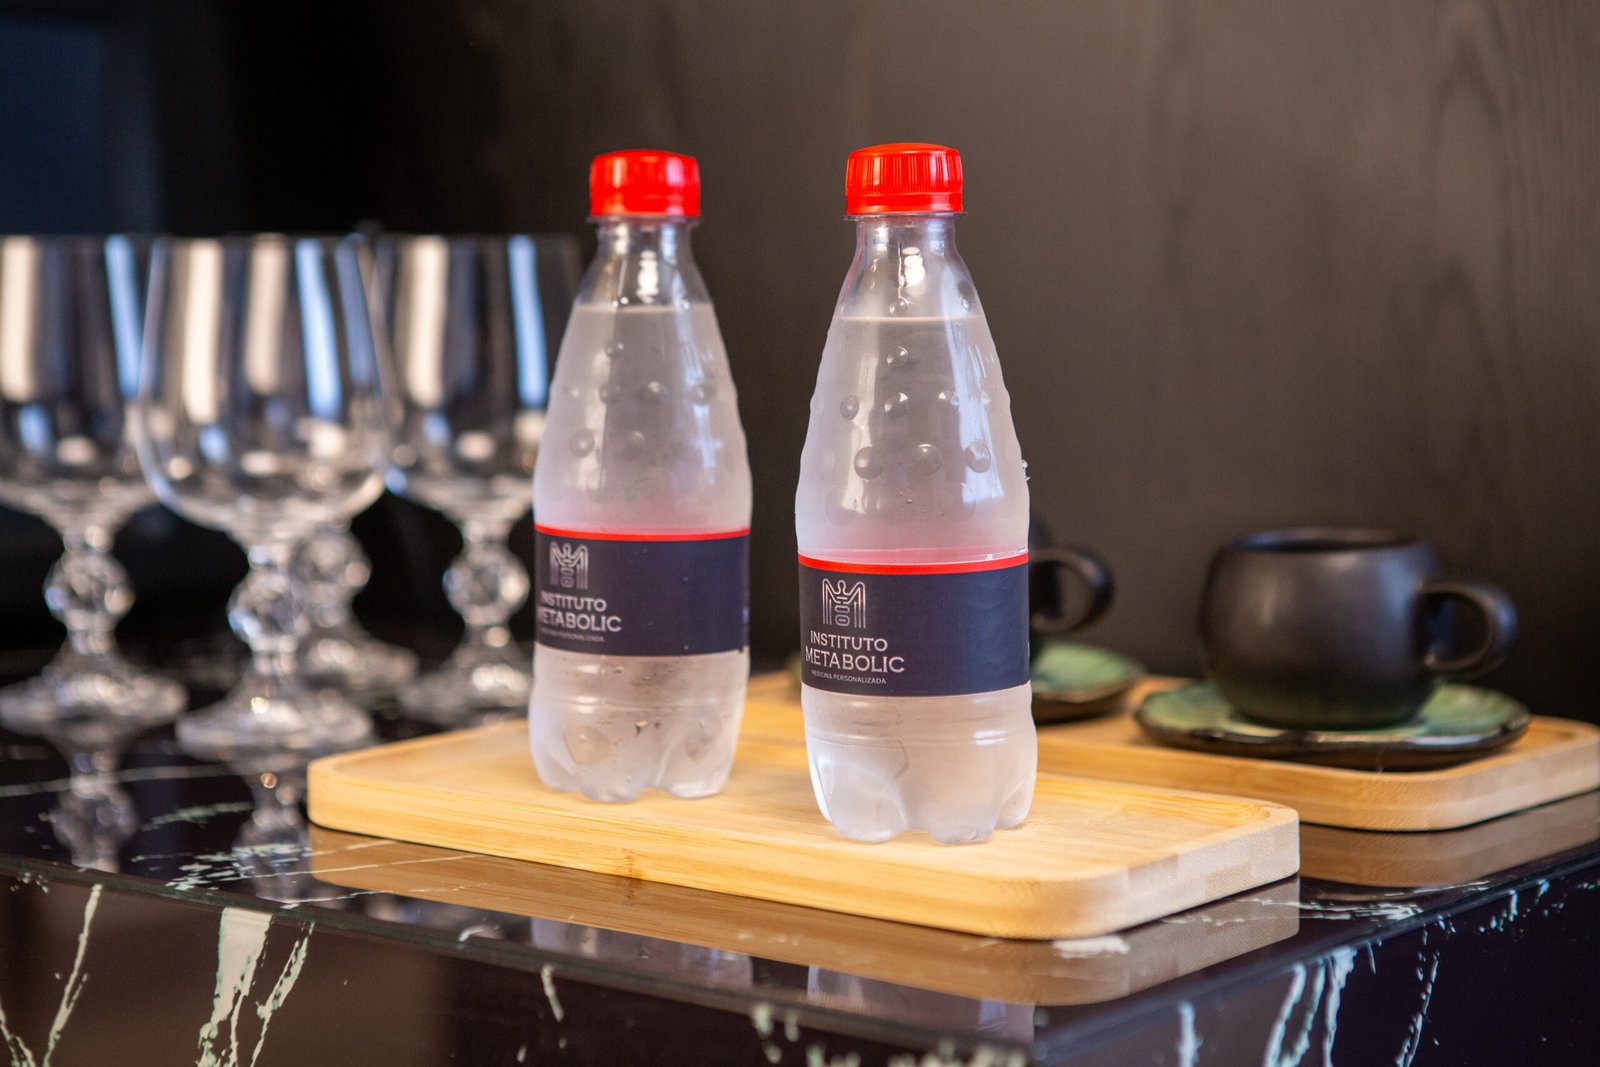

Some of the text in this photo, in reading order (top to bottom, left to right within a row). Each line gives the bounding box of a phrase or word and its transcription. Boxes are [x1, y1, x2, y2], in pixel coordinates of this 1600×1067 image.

[810, 630, 888, 652] INSTITUTO
[805, 646, 905, 673] METABOLIC
[833, 674, 887, 684] PERSONALIZADA
